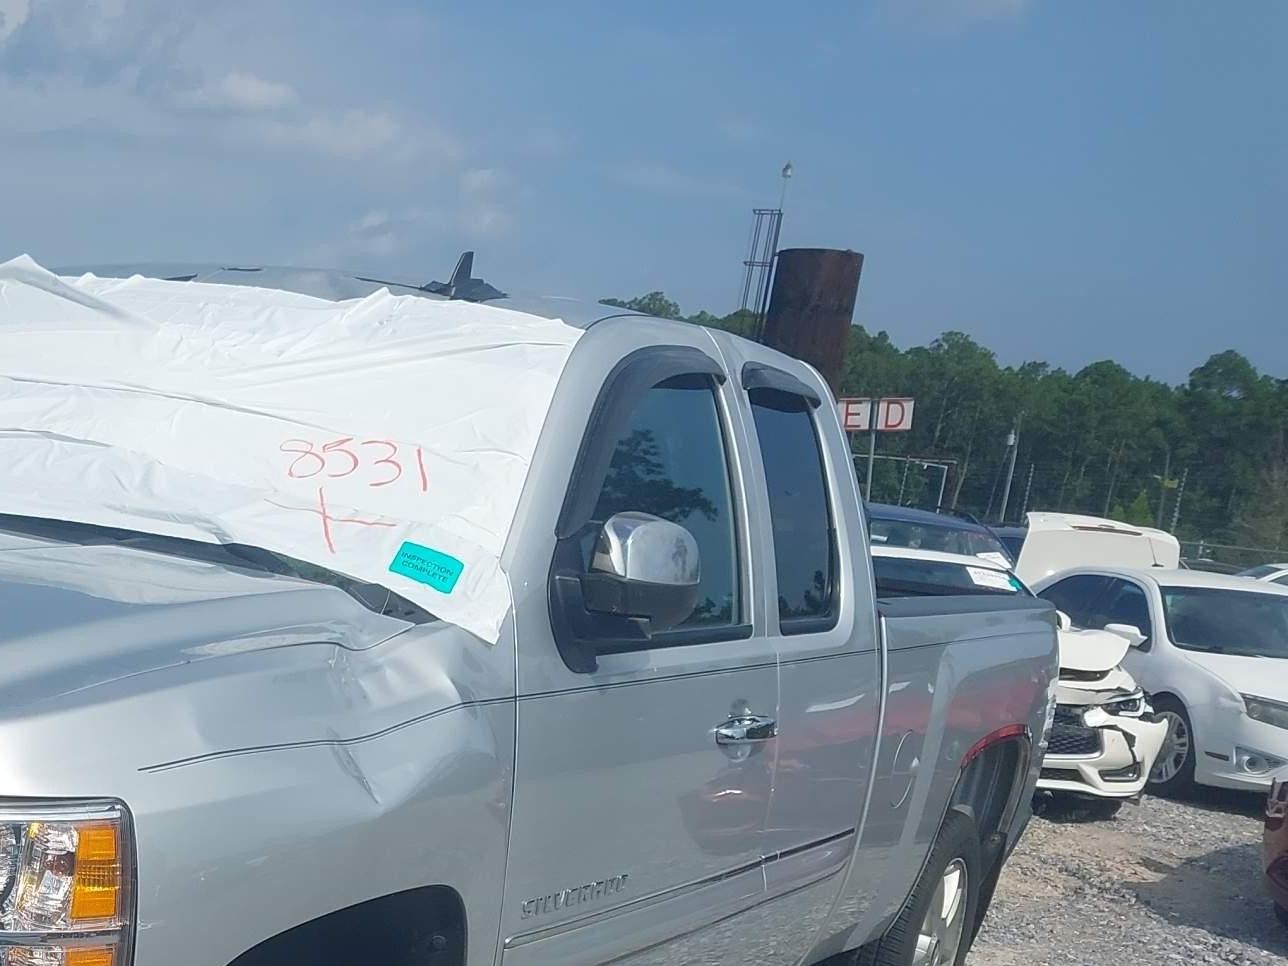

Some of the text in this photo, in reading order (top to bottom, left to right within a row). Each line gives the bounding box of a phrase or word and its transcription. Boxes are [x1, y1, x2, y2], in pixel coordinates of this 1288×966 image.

[844, 400, 905, 428] E D
[280, 437, 429, 492] 8531
[401, 551, 454, 577] INSPECTION
[401, 560, 449, 583] COMPLETE
[520, 874, 629, 917] SILVERADO
